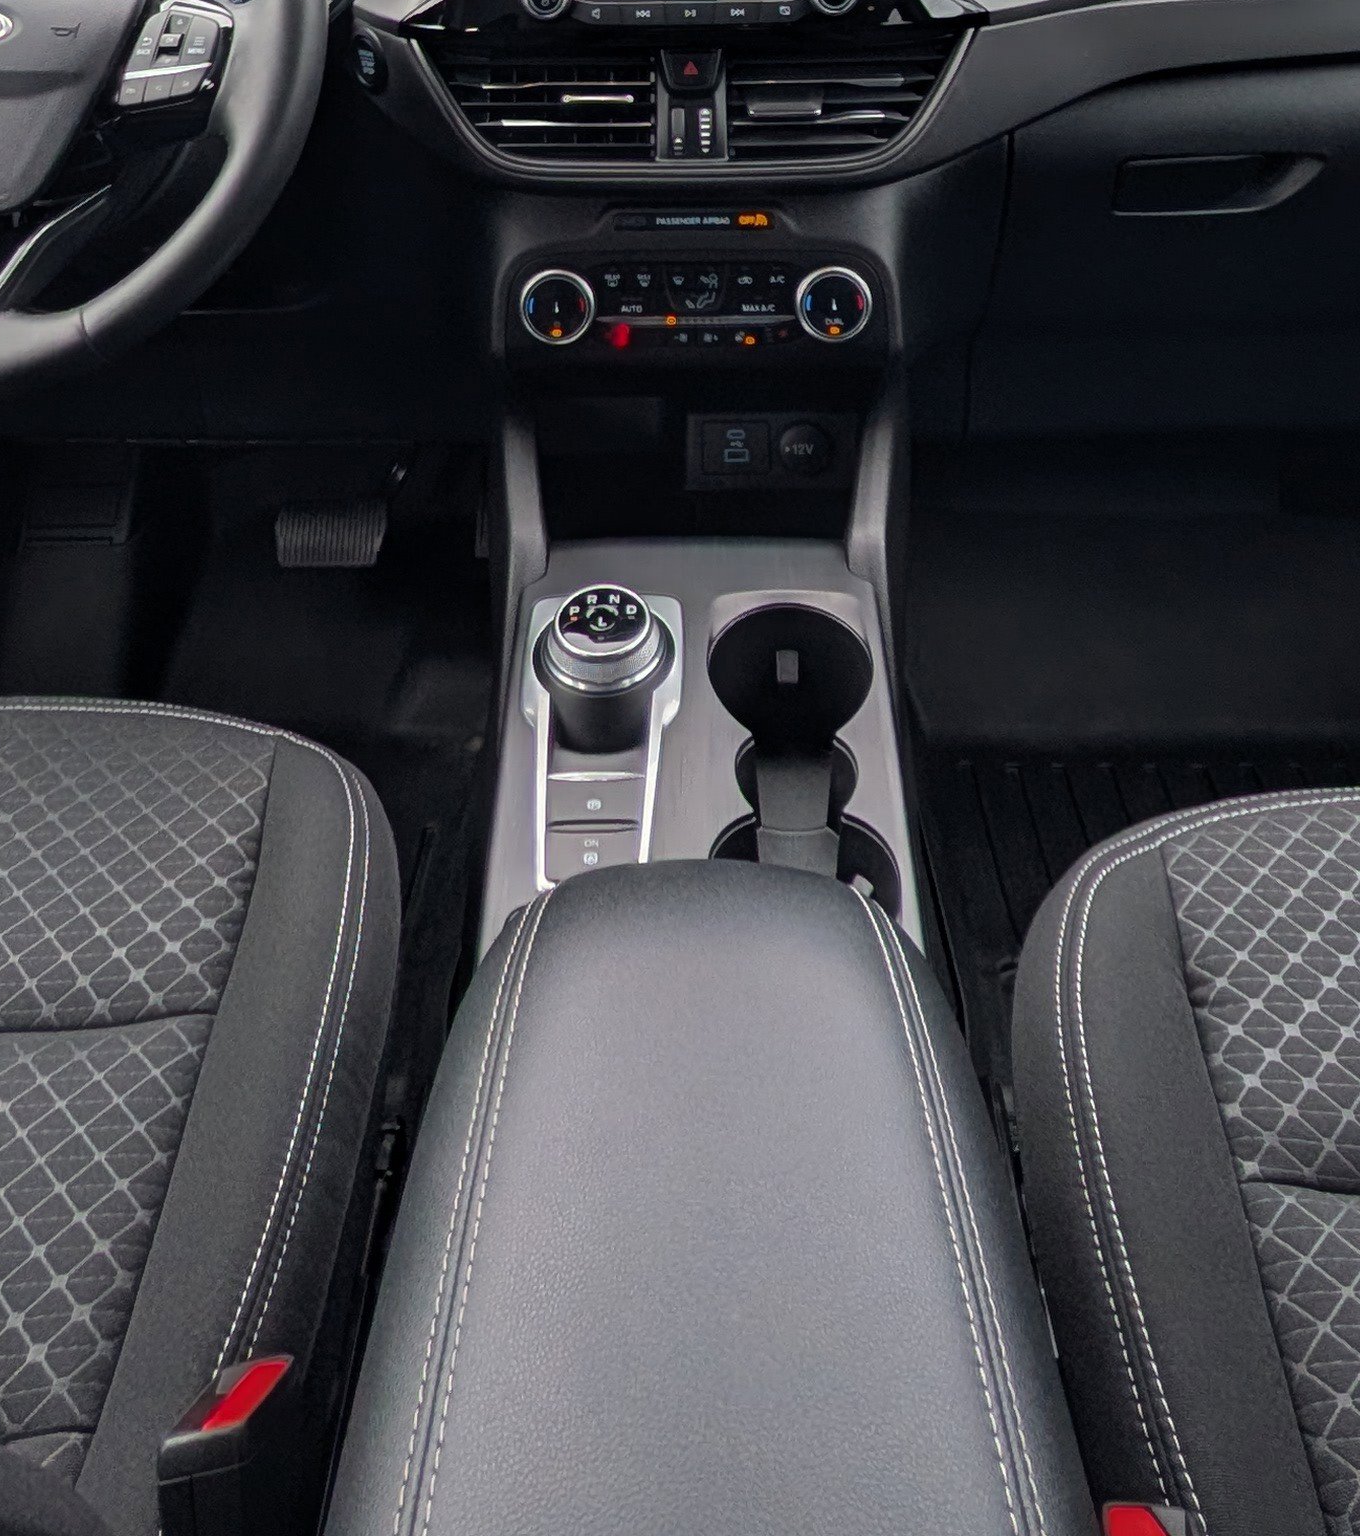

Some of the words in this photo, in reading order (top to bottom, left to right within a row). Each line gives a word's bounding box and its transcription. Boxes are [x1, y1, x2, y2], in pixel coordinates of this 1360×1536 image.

[136, 48, 152, 56] BACK
[187, 47, 206, 56] MENU
[655, 217, 701, 226] PASSENGER
[702, 216, 731, 226] AIRBAG
[769, 275, 786, 284] A/C
[620, 304, 643, 314] AUTO
[741, 304, 760, 313] MAX
[760, 304, 776, 313] A/C
[792, 443, 815, 456] 12V
[586, 594, 598, 605] R
[608, 594, 621, 605] N
[569, 605, 580, 616] P
[625, 604, 638, 615] D
[596, 616, 608, 627] L
[584, 838, 600, 848] ON
